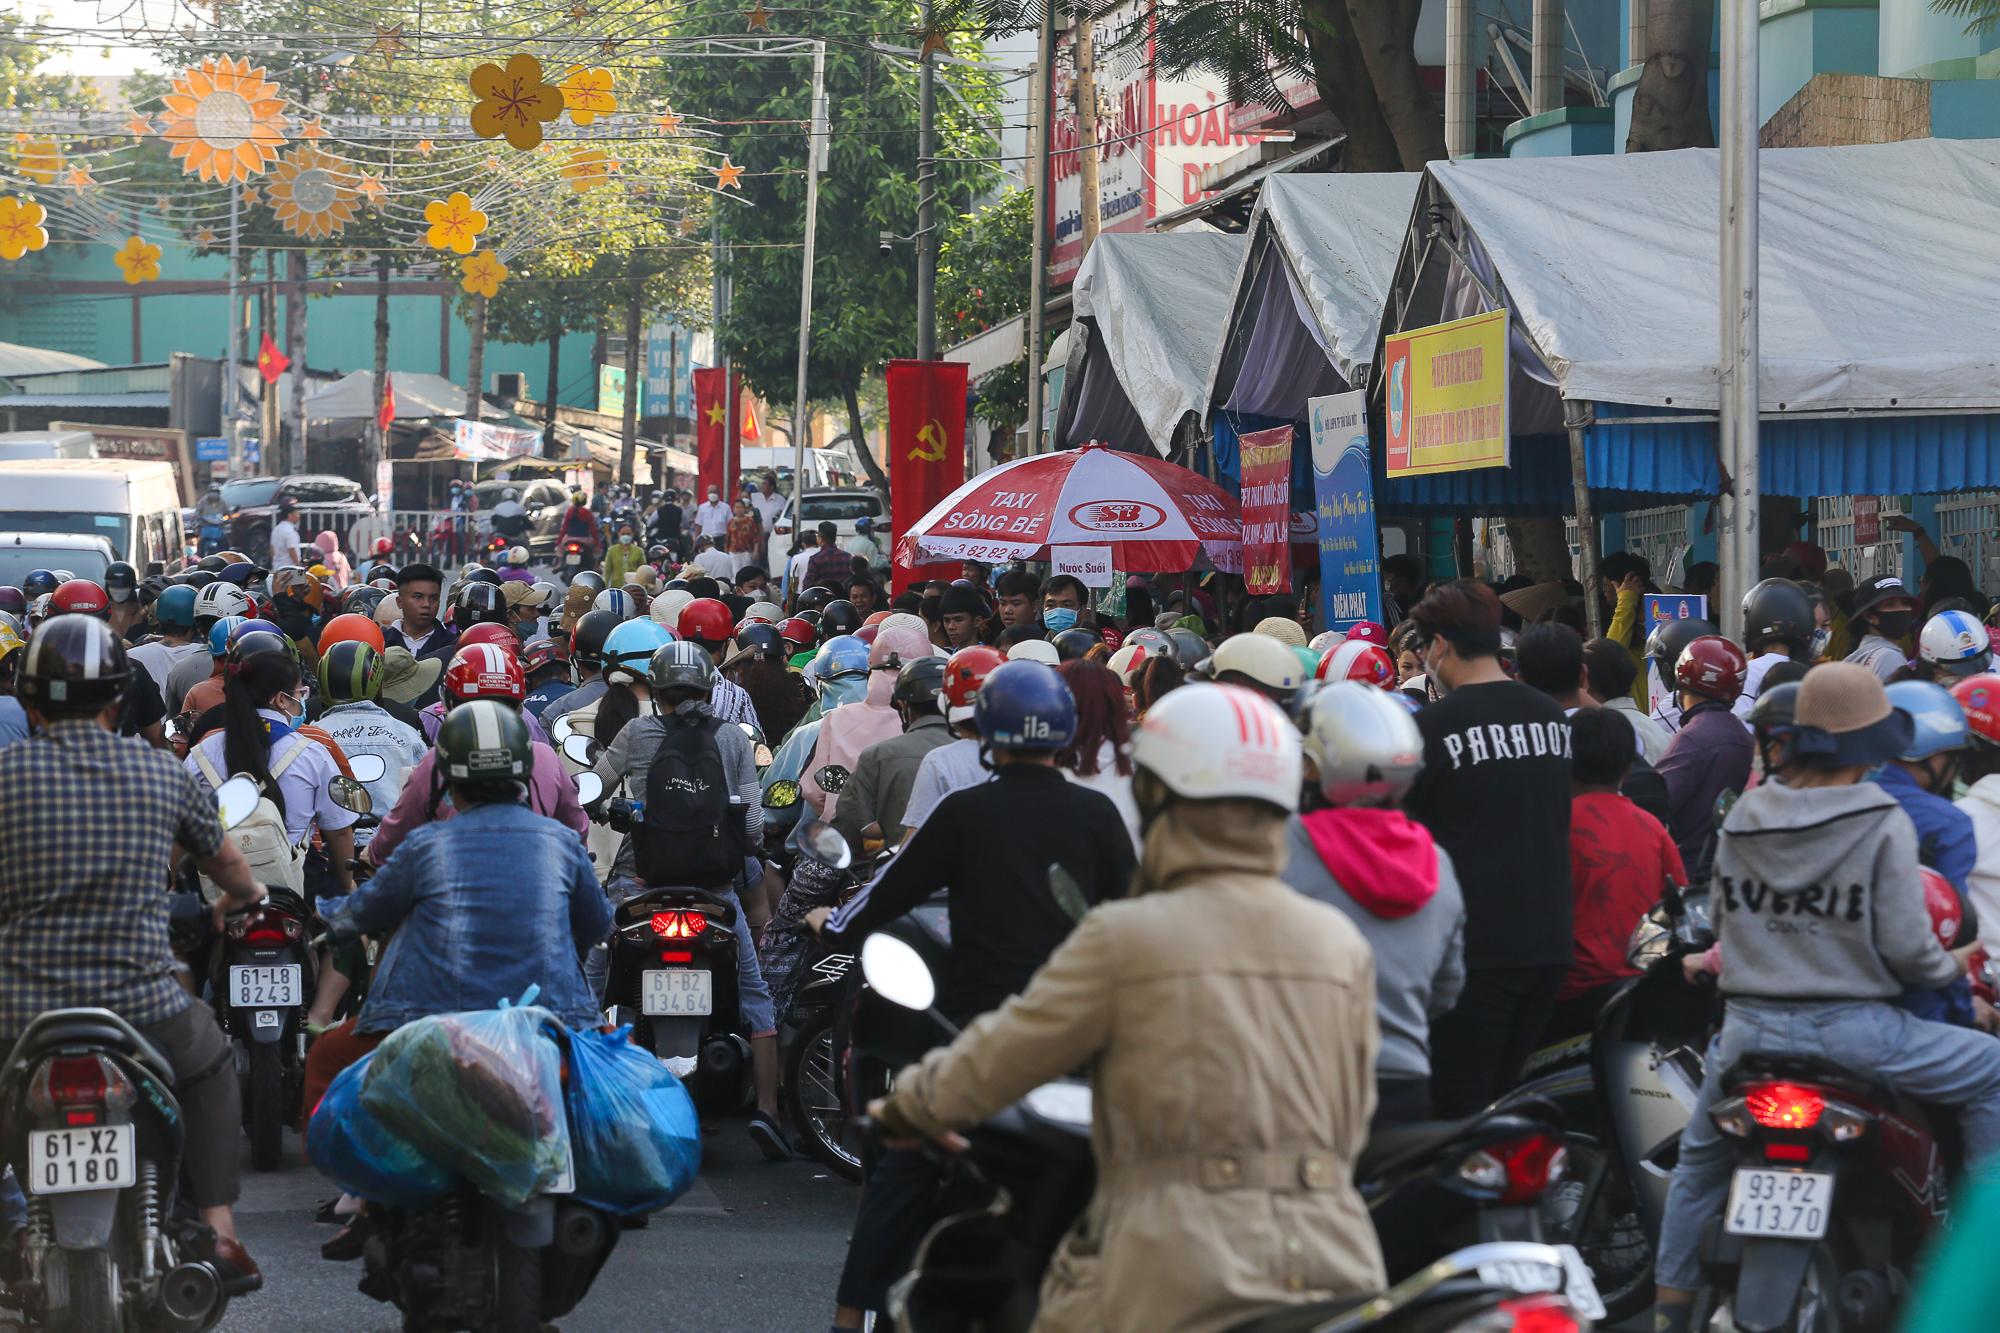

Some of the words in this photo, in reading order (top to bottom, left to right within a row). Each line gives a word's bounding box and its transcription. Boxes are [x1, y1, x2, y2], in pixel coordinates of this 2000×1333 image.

[1158, 93, 1265, 146] HOÀ
[990, 491, 1038, 509] TAXI
[1182, 493, 1226, 511] TAXI
[944, 509, 1009, 531] SÔNG
[1008, 513, 1046, 535] BÉ
[1189, 512, 1235, 534] SÔNG
[1059, 562, 1083, 573] Nước
[1349, 589, 1367, 618] PHÁT
[523, 694, 548, 704] FILA
[331, 725, 365, 740] appy
[1024, 715, 1050, 739] ila
[1443, 721, 1573, 770] PARADOX
[241, 968, 290, 985] 61-L8
[654, 973, 701, 992] 61-B2
[241, 986, 291, 1004] 8243
[648, 993, 707, 1012] 134.64
[1630, 1087, 1672, 1100] HONDA
[46, 1130, 118, 1158] 61-X2
[46, 1157, 118, 1186] 0180
[1749, 1174, 1816, 1204] 93-P2
[1734, 1203, 1821, 1233] 413.70
